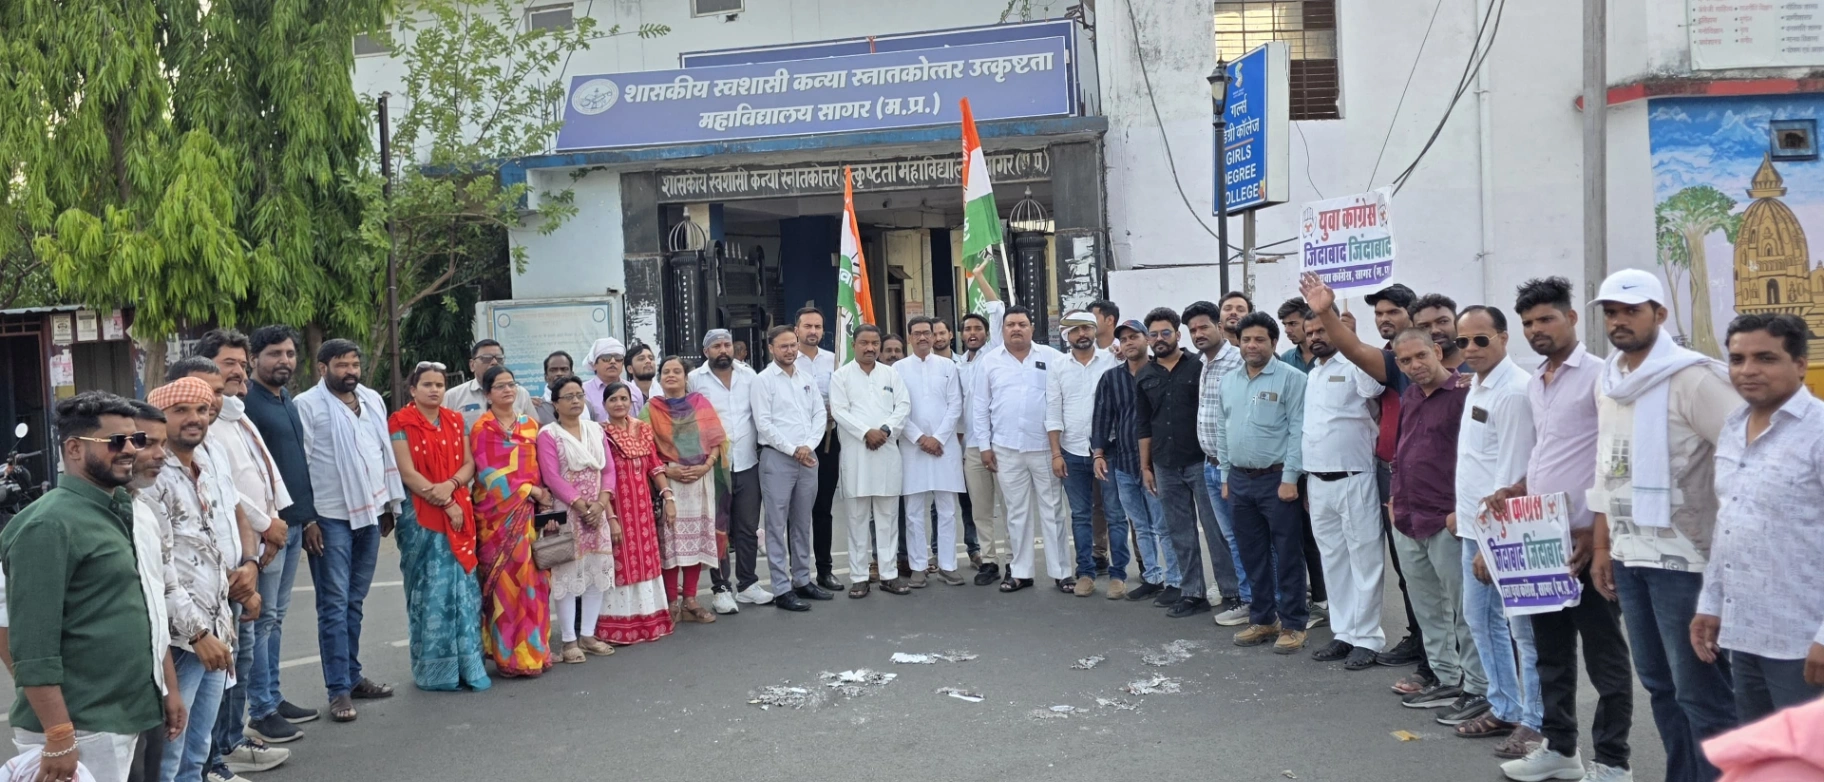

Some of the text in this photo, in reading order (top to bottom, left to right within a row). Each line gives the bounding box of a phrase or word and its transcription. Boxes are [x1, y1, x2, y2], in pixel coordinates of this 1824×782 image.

[624, 75, 710, 103] शासकीय
[713, 67, 790, 98] स्वशासी
[793, 69, 848, 91] कन्या
[851, 55, 965, 87] स्नातकोत्तर
[968, 52, 1054, 83] उत्कृष्टता
[698, 91, 941, 131] महाविद्यालय सागर (म.प्र.)
[1230, 93, 1248, 118] गर्ल्स
[1236, 115, 1260, 139] कॉलेज
[1226, 144, 1252, 166] GIRLS
[661, 170, 707, 198] शासकीय
[709, 167, 749, 194] स्वशासी
[750, 169, 780, 191] कन्या
[780, 163, 841, 192] स्नातकोत्तर
[898, 156, 963, 182] महाविद्याल
[1225, 182, 1259, 205] OLLEGE
[1318, 198, 1377, 242] युवा कांग्रेस
[1304, 233, 1392, 268] जिंदाबाद जिंदाबाद
[1487, 535, 1527, 573] जिंदाबाद
